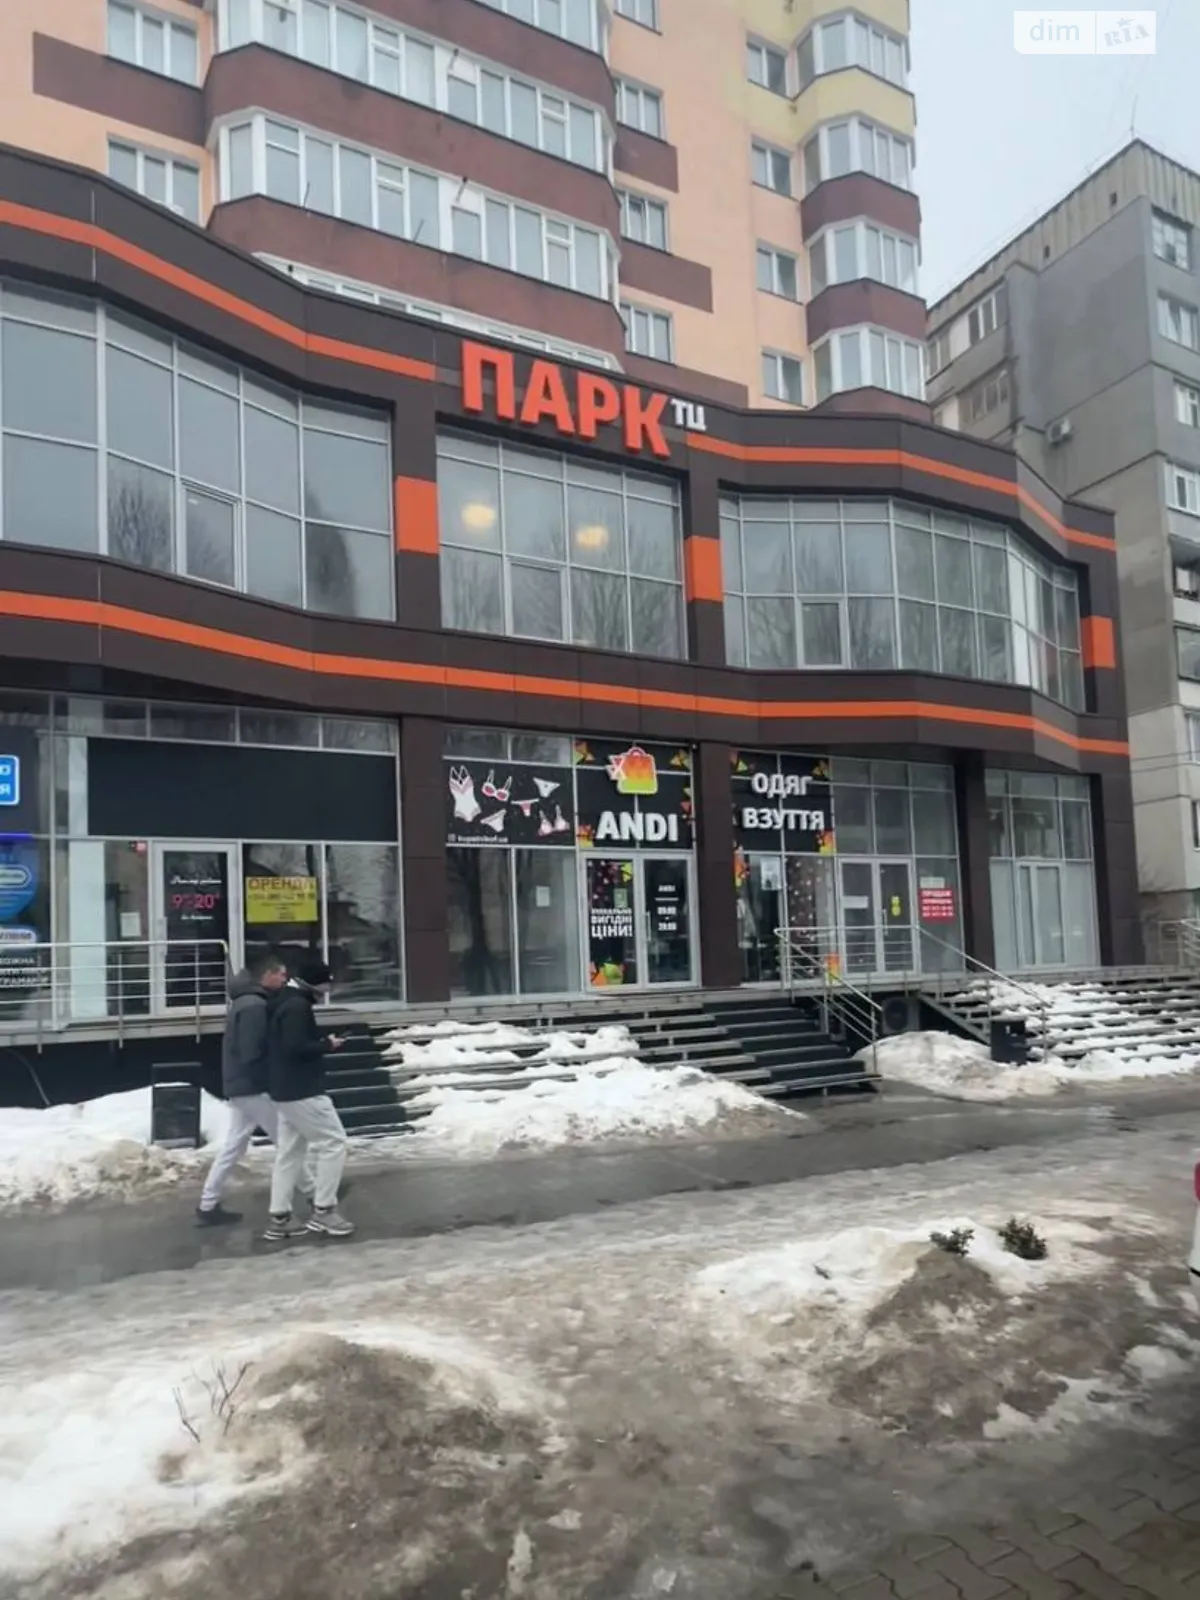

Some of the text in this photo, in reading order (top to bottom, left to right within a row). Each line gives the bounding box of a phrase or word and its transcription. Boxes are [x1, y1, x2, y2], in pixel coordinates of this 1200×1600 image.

[462, 339, 671, 459] ПАРК
[751, 773, 813, 799] ОДЯГ
[596, 810, 679, 842] ANDI
[742, 807, 825, 830] ВЗУТТЯ
[591, 925, 632, 940] ЦІНИ!
